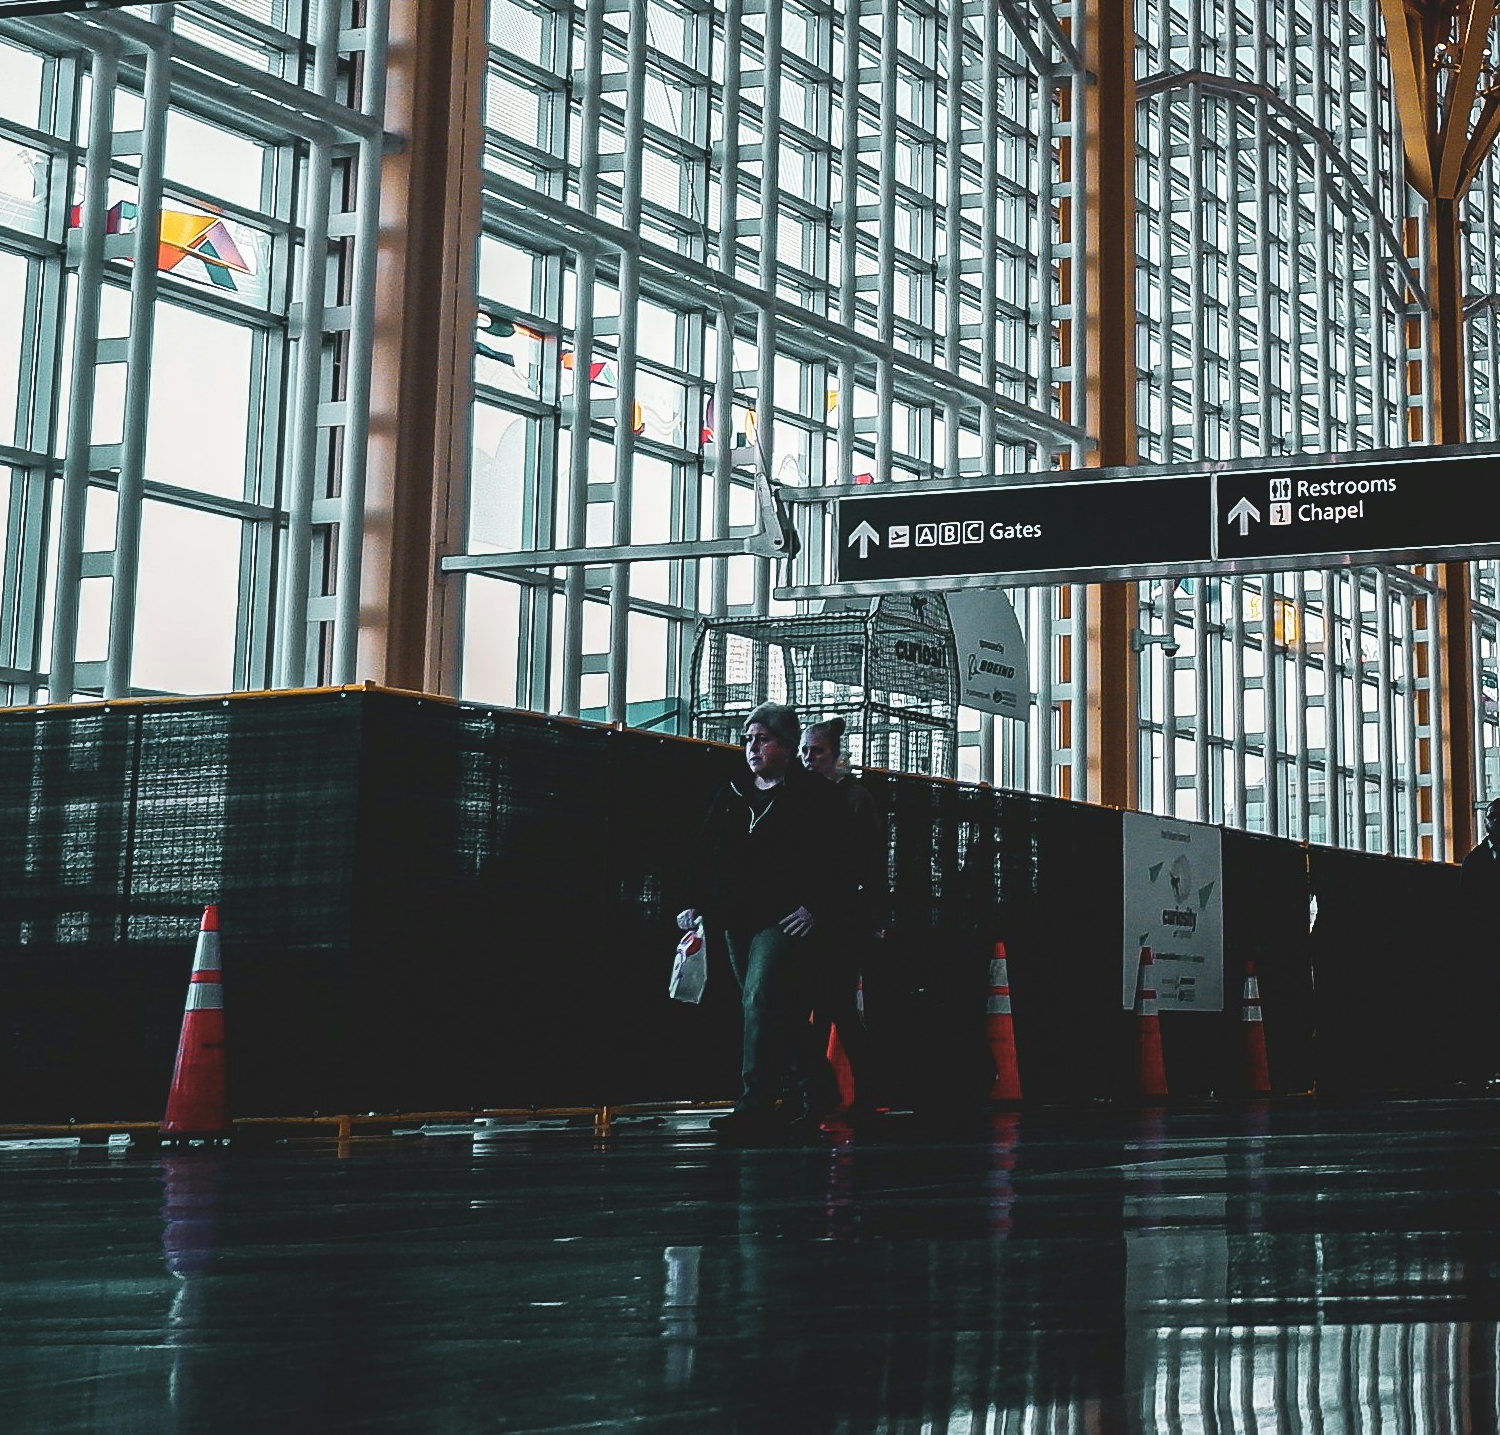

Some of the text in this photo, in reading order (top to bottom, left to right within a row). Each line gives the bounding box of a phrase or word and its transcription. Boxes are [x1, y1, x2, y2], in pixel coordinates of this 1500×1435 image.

[1297, 478, 1397, 498] Restrooms
[1298, 499, 1364, 523] Chapel
[989, 522, 1042, 540] Gates
